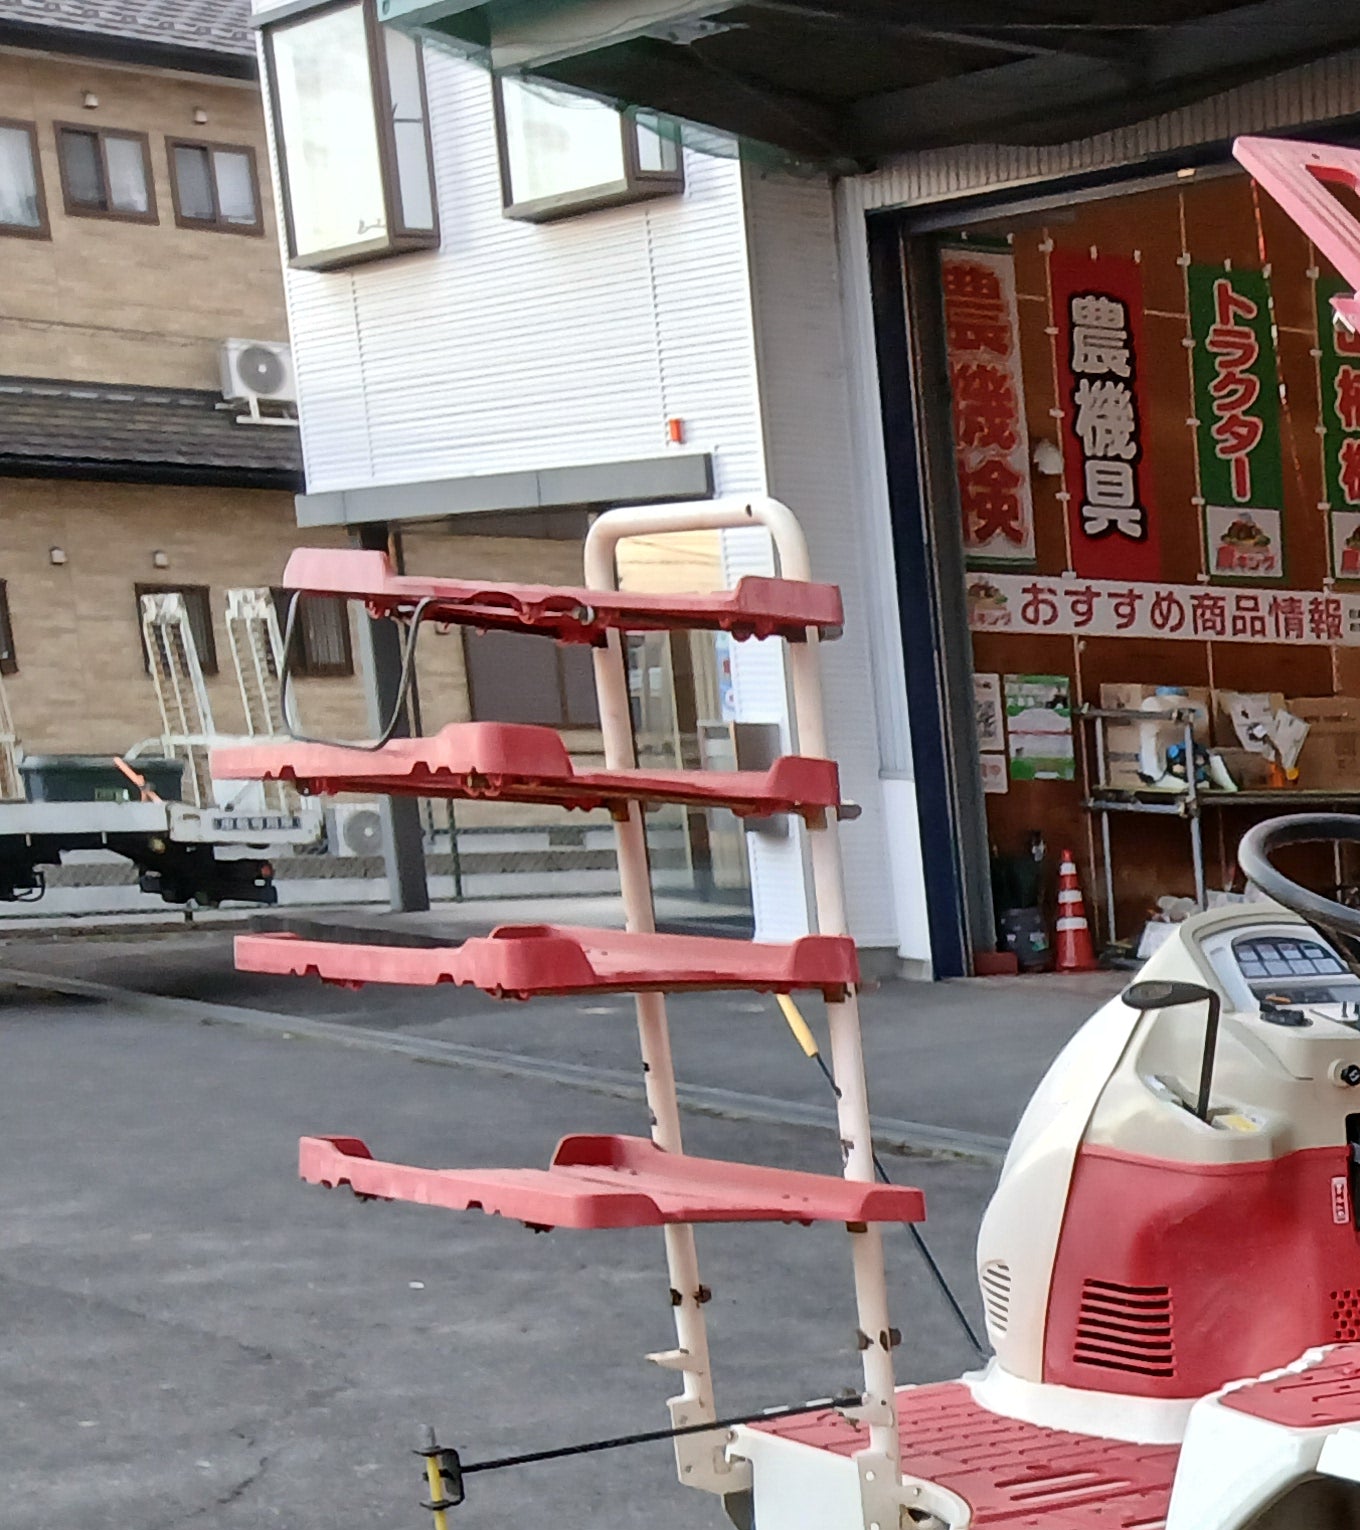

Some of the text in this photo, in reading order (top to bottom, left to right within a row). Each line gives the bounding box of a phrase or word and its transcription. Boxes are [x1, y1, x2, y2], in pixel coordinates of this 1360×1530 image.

[1070, 293, 1144, 538] 農機具
[1205, 279, 1263, 501] トラクター
[1019, 581, 1344, 641] おすすめ商品情報
